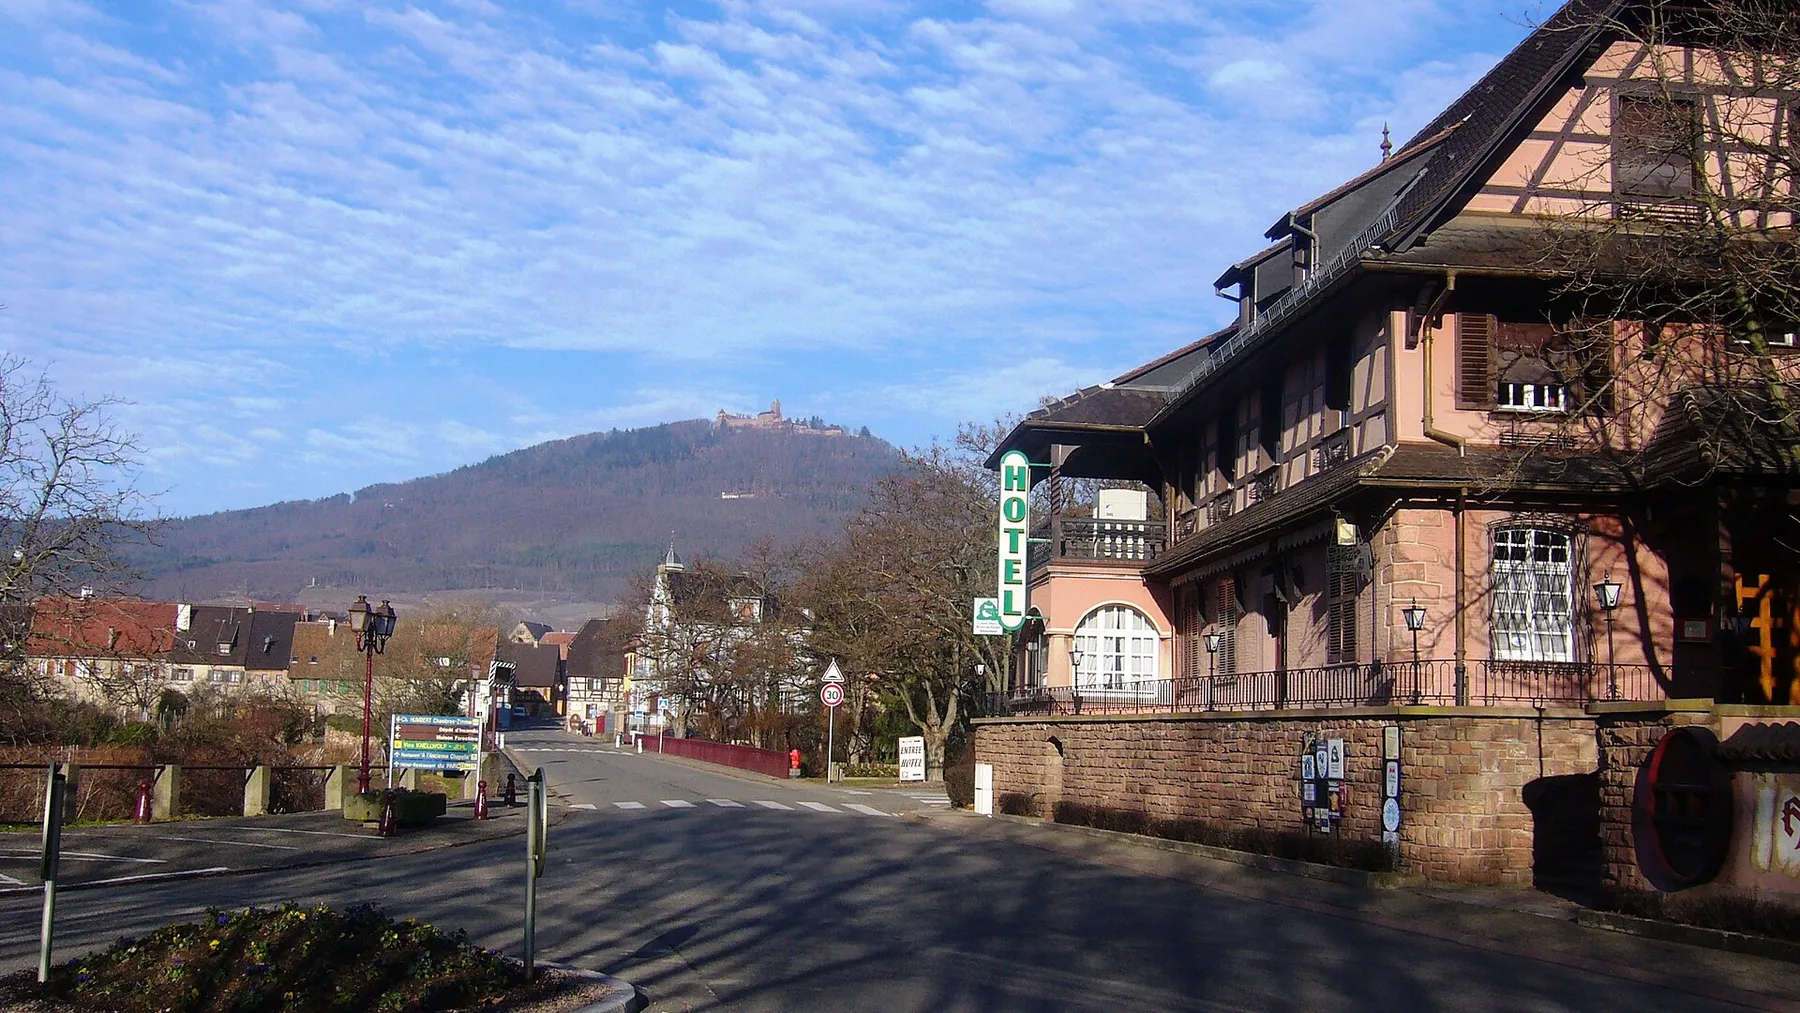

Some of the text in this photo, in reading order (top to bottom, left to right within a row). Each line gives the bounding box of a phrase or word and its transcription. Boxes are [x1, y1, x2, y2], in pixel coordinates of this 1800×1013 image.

[1003, 465, 1027, 616] HOTEL
[826, 690, 839, 700] 30
[901, 759, 922, 767] HOTEL
